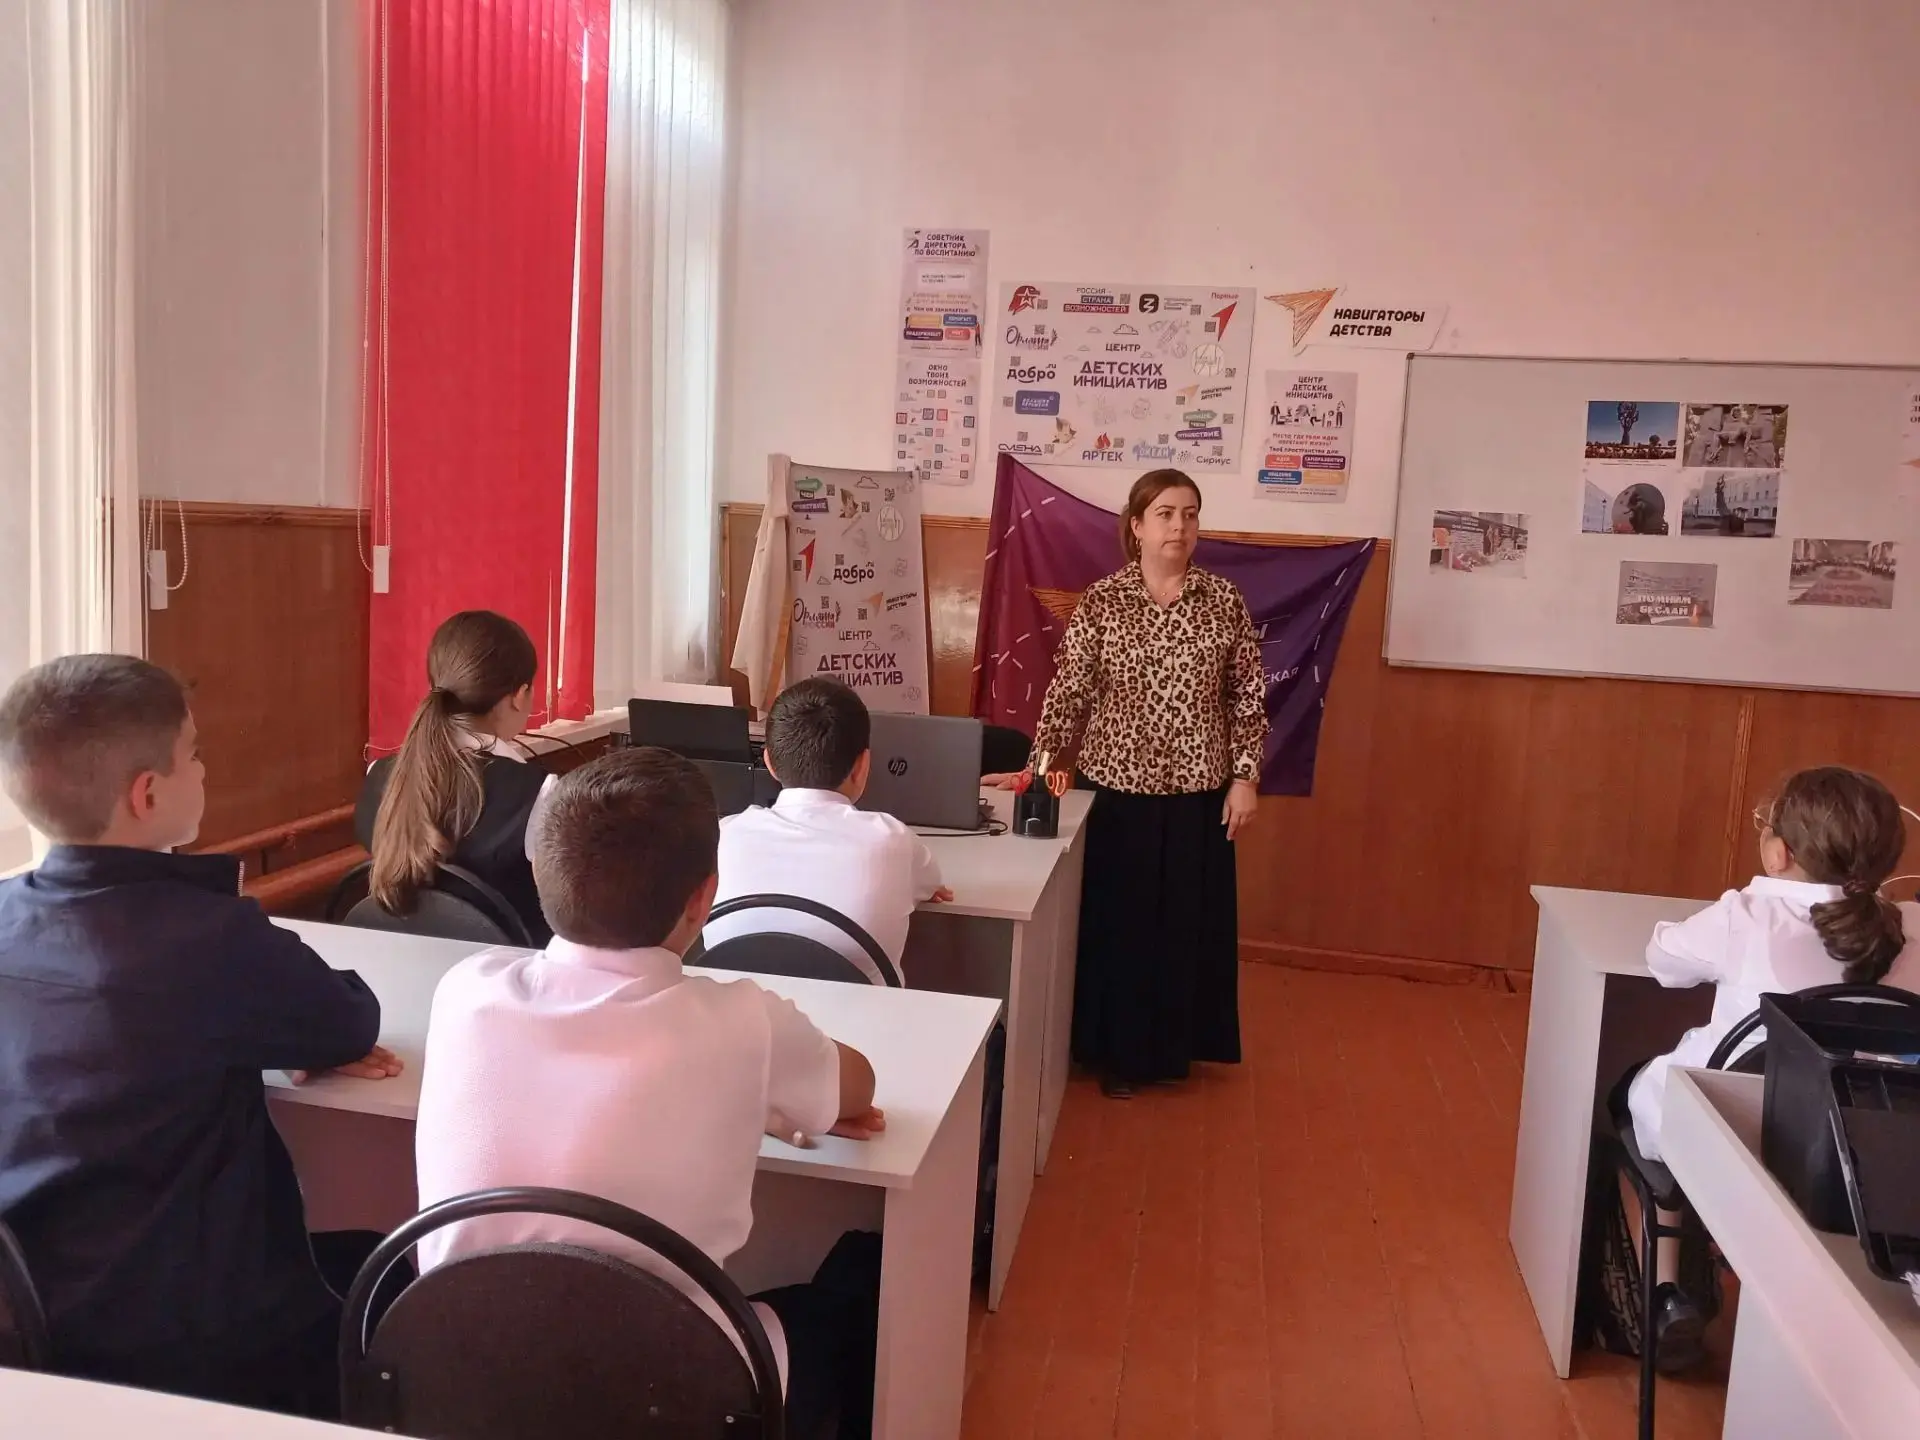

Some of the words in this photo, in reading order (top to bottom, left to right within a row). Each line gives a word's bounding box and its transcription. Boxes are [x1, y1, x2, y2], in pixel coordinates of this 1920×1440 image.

[926, 233, 965, 242] СОВЕТНИК
[923, 240, 967, 249] ДИРЕКТОРА
[925, 249, 976, 257] ВОСПИТАНИЮ
[1065, 304, 1127, 313] ВОЗМОЖНОСТЕЙ
[1333, 308, 1425, 322] НАВИГАТОРЫ
[1329, 324, 1392, 337] ДЕТСТВА
[1105, 343, 1141, 352] ЦЕНТР
[1080, 360, 1163, 376] ДЕТСКИХ
[926, 371, 949, 379] ТВОИХ
[1007, 366, 1056, 382] добро
[908, 378, 967, 387] ВОЗМОЖНОСТЕЙ
[1073, 375, 1168, 390] ИНИЦИАТИВ
[1298, 376, 1324, 384] ЦЕНТР
[1292, 383, 1328, 392] ДЕТСКИХ
[1285, 391, 1333, 400] ИНИЦИАТИВ
[1082, 450, 1124, 462] АРТЕК
[1196, 455, 1231, 466] Сириус
[833, 565, 875, 583] добро
[838, 630, 873, 641] ЦЕНТР
[817, 653, 897, 672] ДЕТСКИХ
[837, 671, 904, 688] ЦИАТИВ
[889, 758, 907, 776] hp
